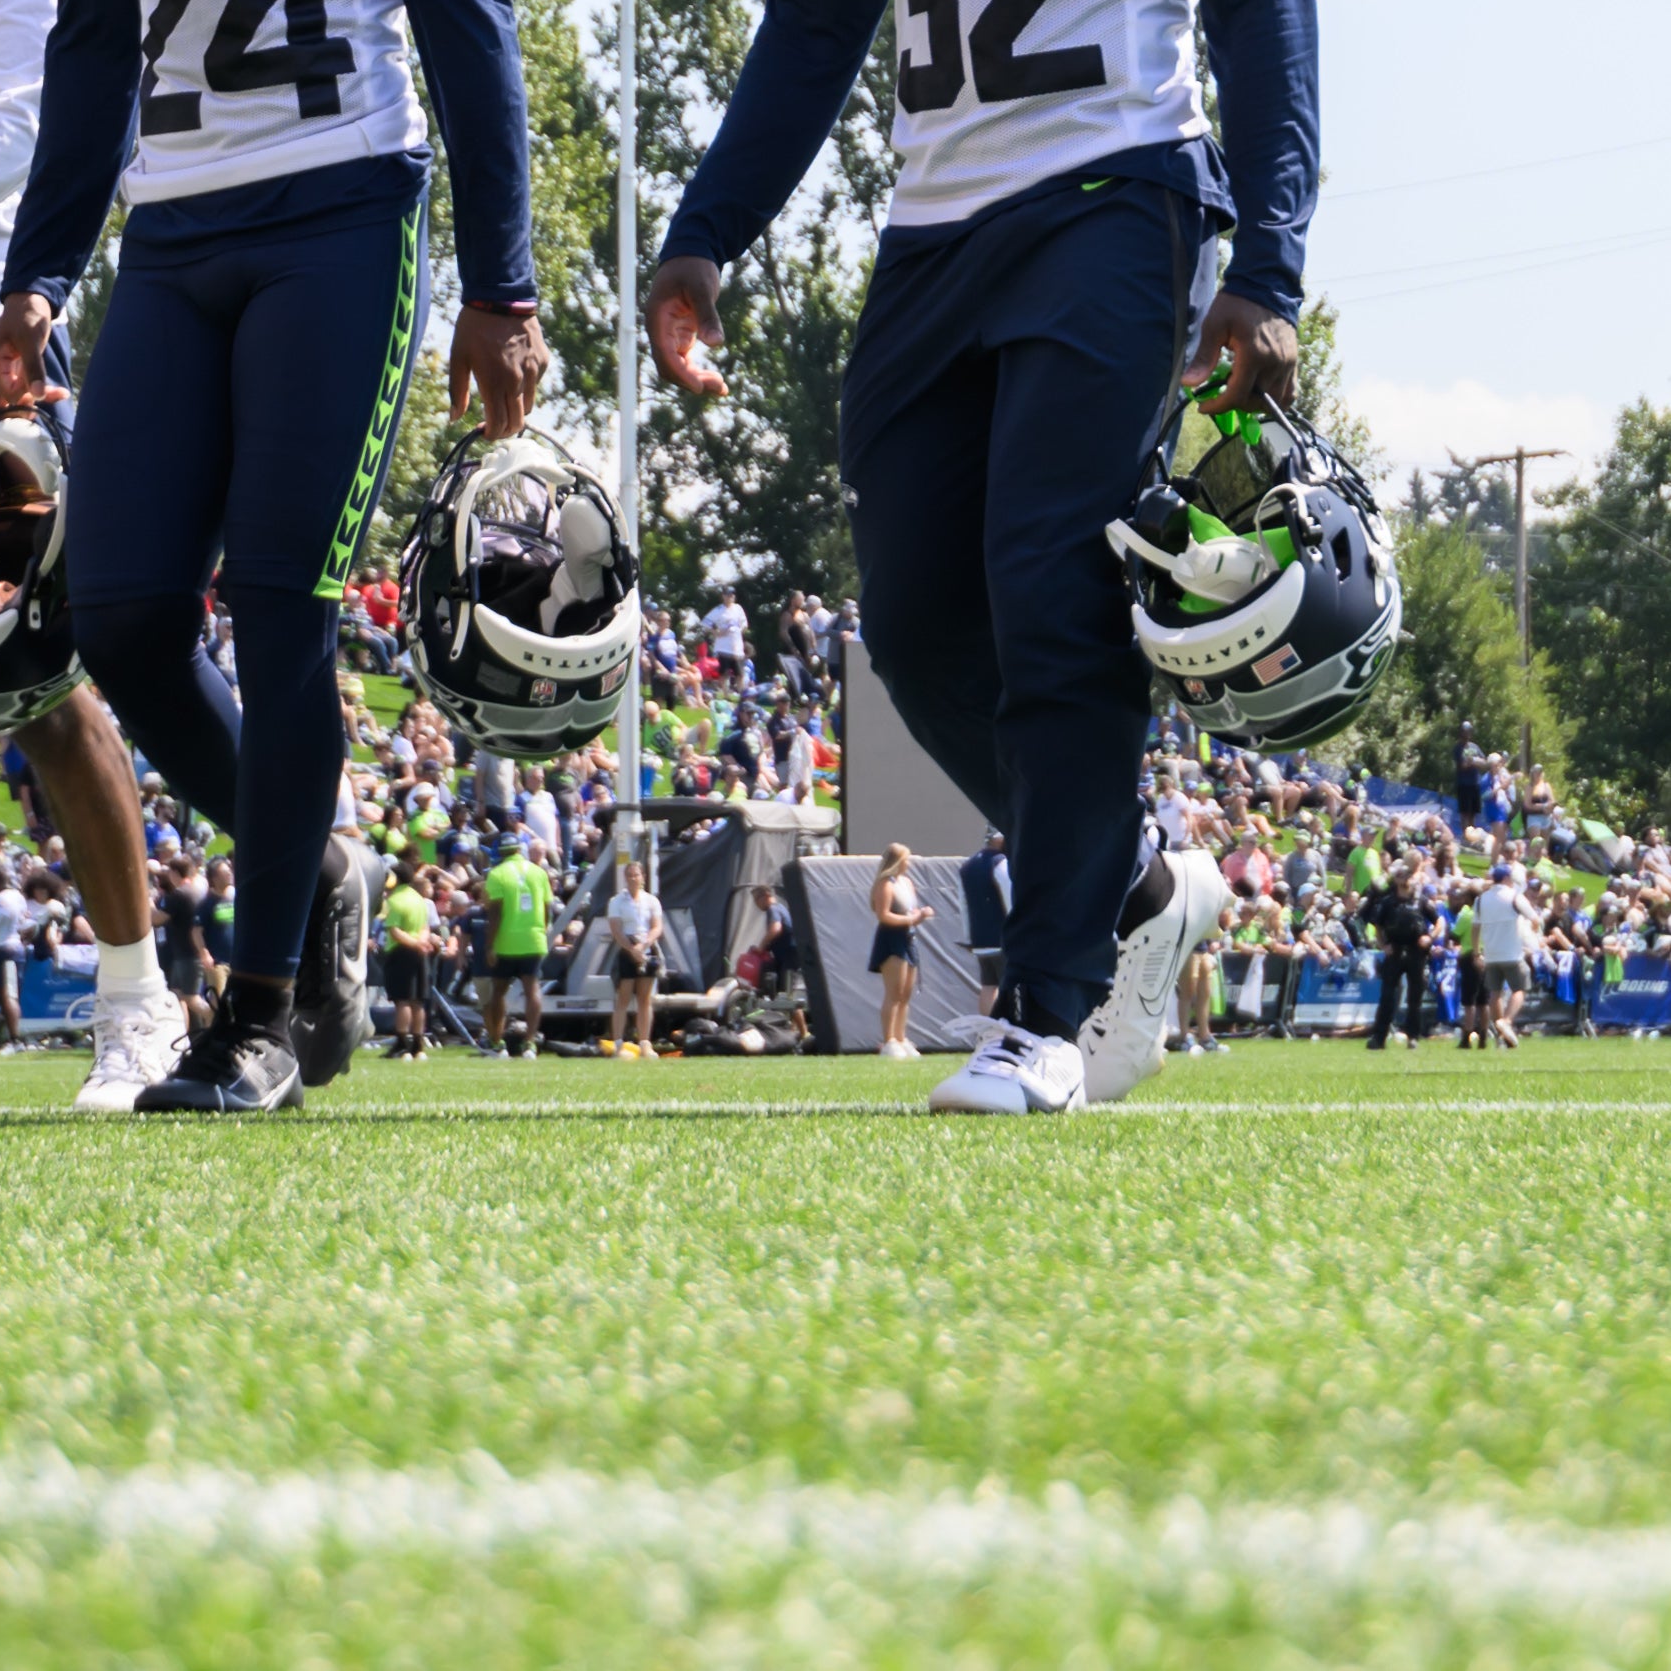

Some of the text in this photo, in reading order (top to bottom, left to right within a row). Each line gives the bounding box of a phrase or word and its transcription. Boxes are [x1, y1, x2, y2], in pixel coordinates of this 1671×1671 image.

[522, 641, 627, 670] SEATTLE
[1157, 625, 1266, 666] SEATTLE
[1618, 979, 1670, 994] BOEING
